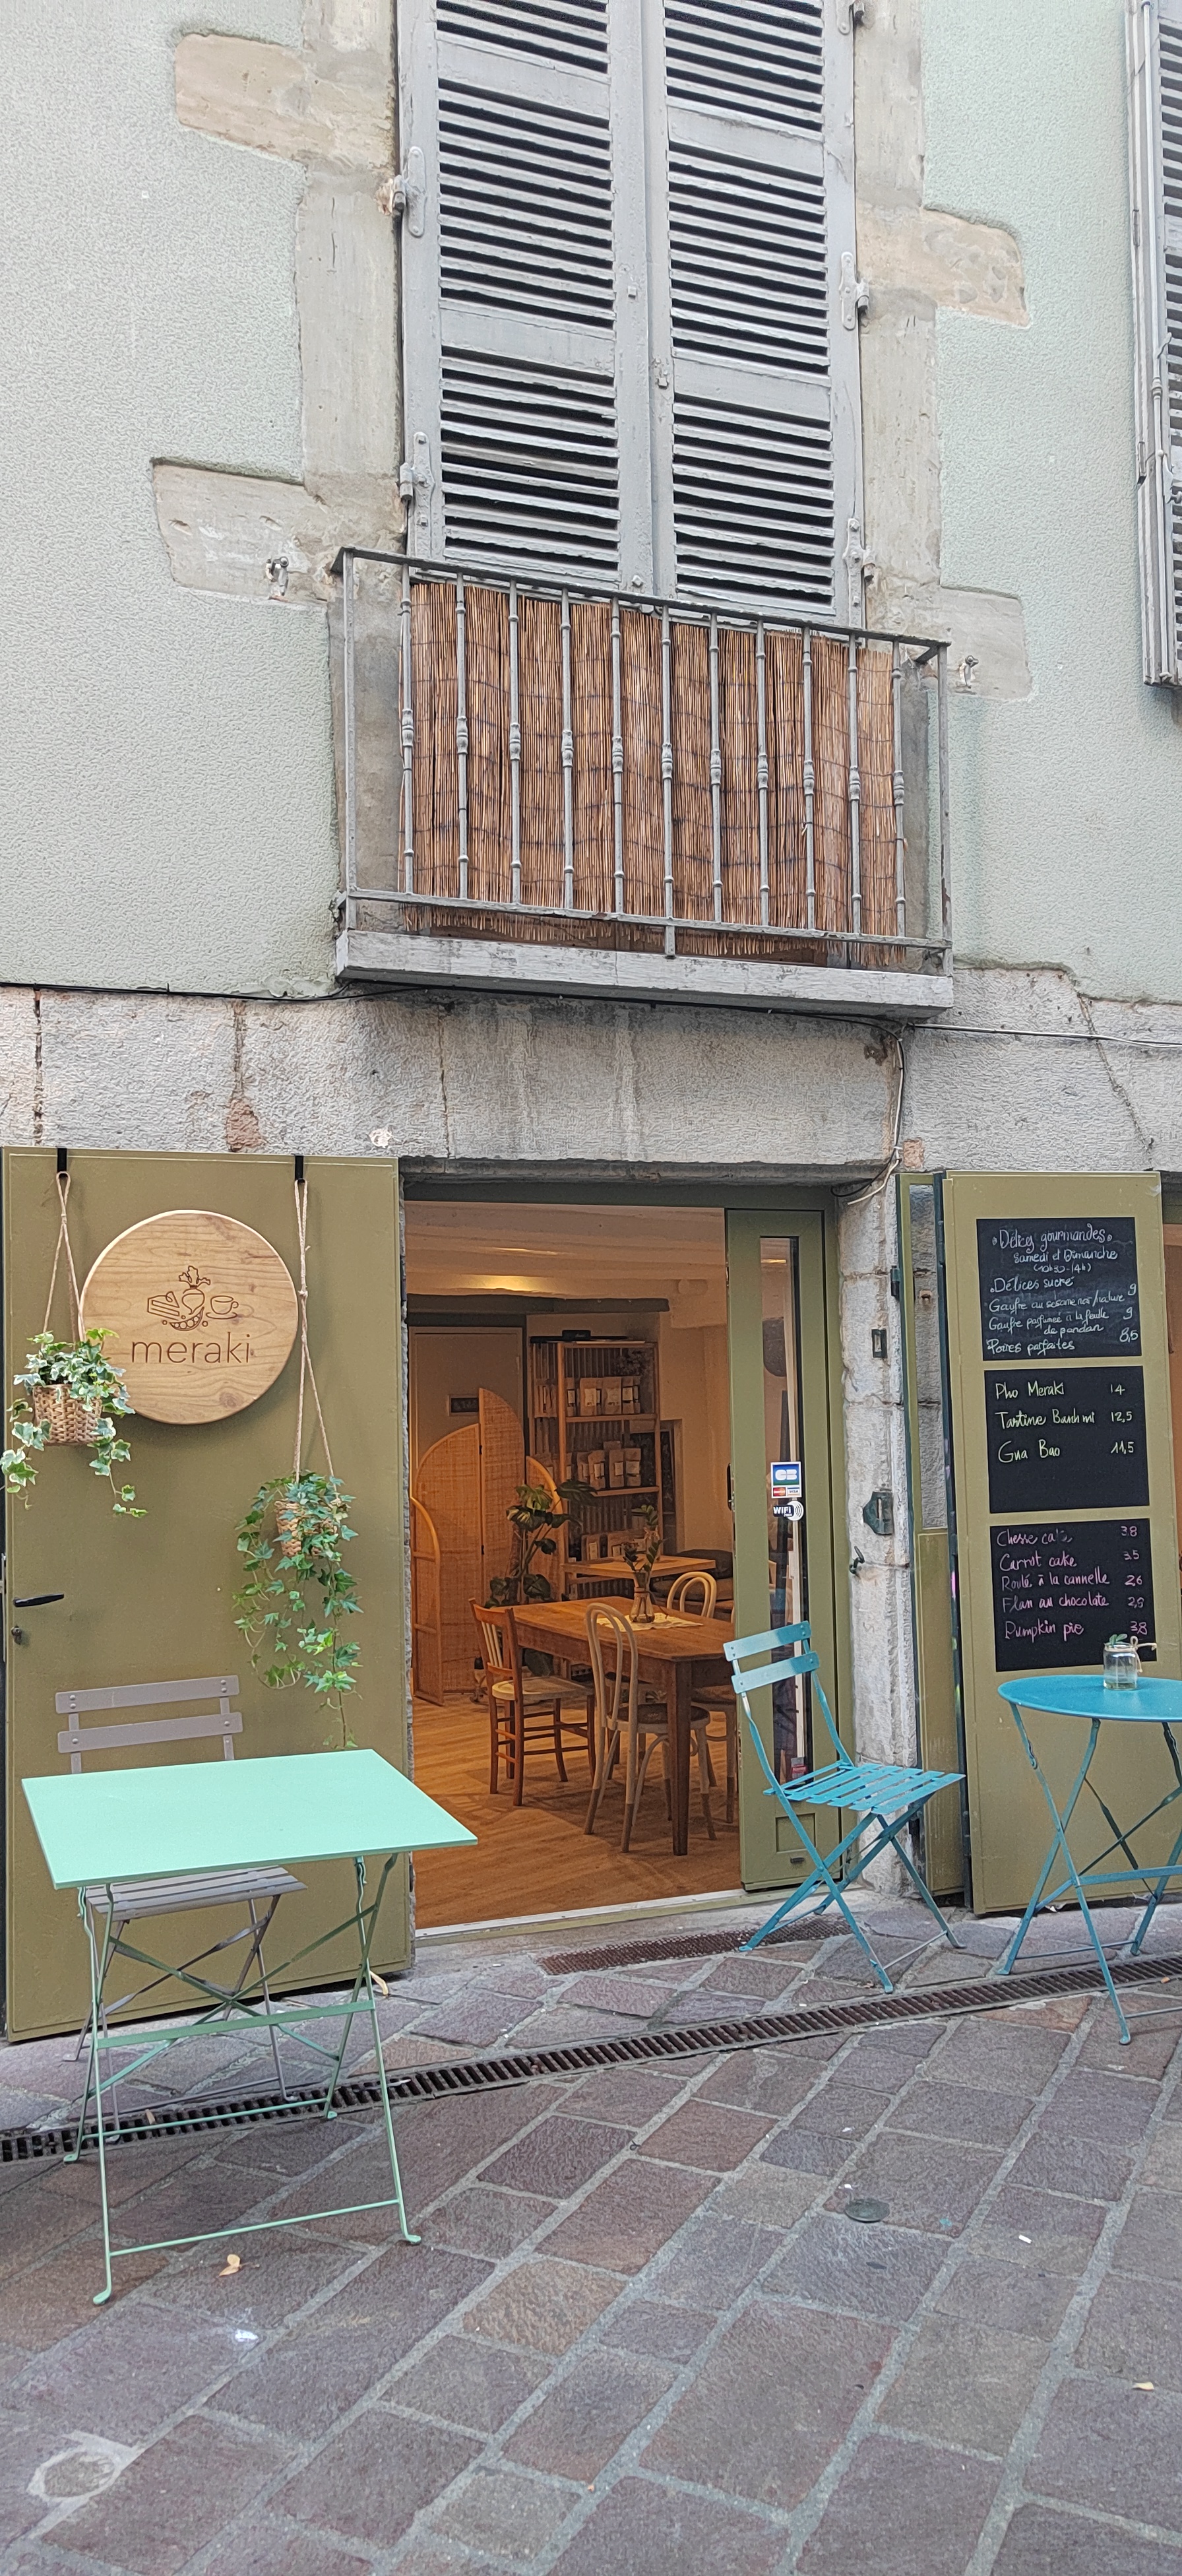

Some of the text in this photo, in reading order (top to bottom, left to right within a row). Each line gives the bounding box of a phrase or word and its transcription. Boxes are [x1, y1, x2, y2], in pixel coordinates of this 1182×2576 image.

[1040, 1223, 1105, 1252] gourmandes
[1052, 1248, 1061, 1260] et
[1064, 1245, 1118, 1262] Dimanche
[994, 1275, 1074, 1293] Délices sucré
[989, 1297, 1028, 1315] Gaufre
[1127, 1283, 1136, 1296] 9
[989, 1316, 1023, 1335] Gaufre
[1075, 1310, 1084, 1320] la
[1123, 1306, 1133, 1320] 9
[1043, 1323, 1104, 1339] de pandan
[131, 1332, 251, 1363] meraki
[986, 1327, 1138, 1357] Poires parfaites 8,5
[995, 1382, 1018, 1400] Pho
[1110, 1384, 1125, 1396] 14
[995, 1407, 1133, 1430] Tartine Banh mi 12,5
[1038, 1438, 1061, 1458] Bao
[1110, 1440, 1135, 1454] 11,5
[775, 1469, 797, 1481] CB
[999, 1550, 1042, 1571] Carrot
[1049, 1551, 1077, 1567] cake
[1001, 1573, 1032, 1592] Roulé
[1049, 1572, 1059, 1586] la
[1064, 1566, 1110, 1585] cannelle
[1002, 1595, 1033, 1613] Flan
[1038, 1597, 1053, 1609] au
[1059, 1591, 1109, 1607] chocolate
[1005, 1618, 1056, 1643] Pumpkin
[1063, 1622, 1084, 1642] pie
